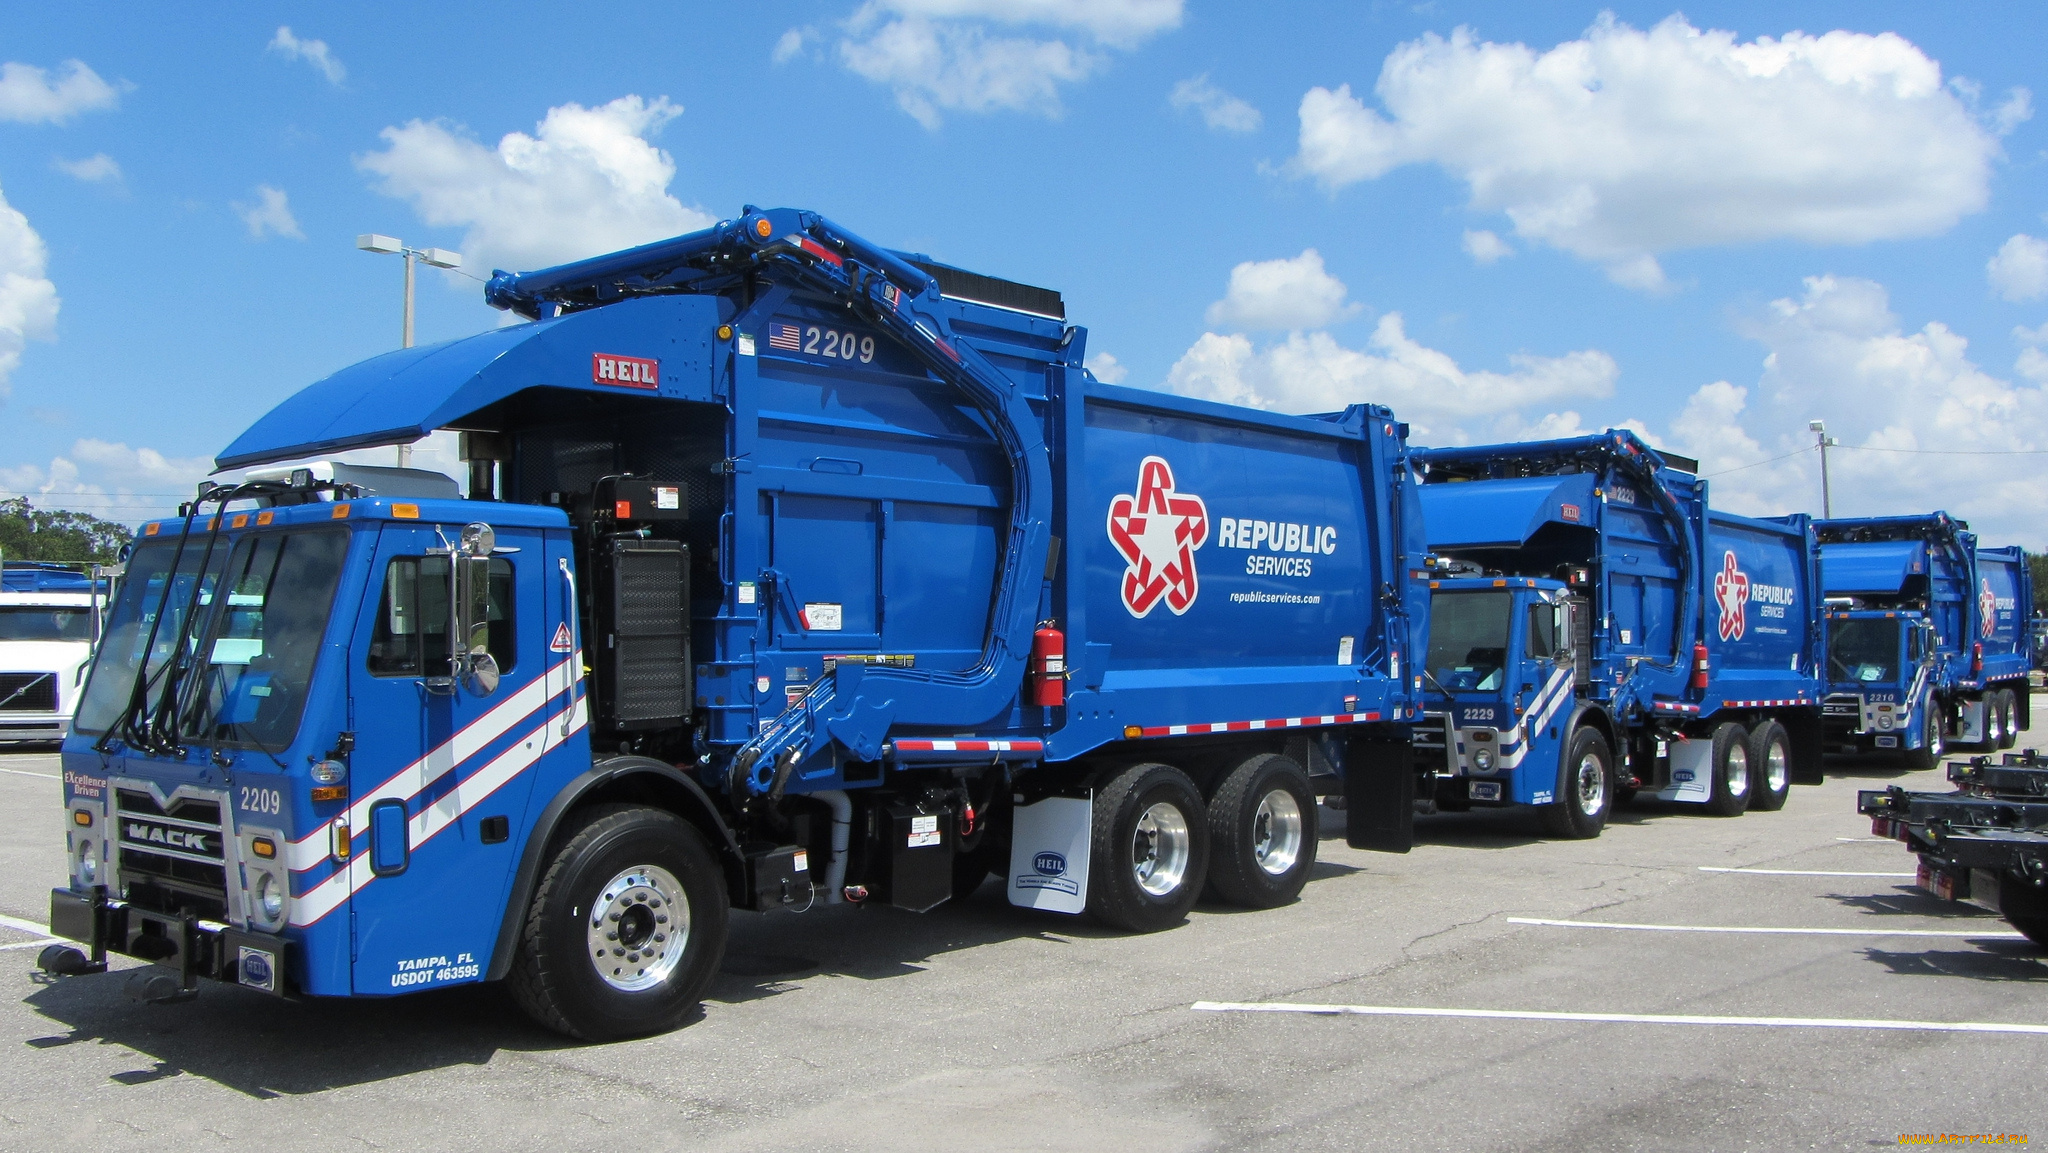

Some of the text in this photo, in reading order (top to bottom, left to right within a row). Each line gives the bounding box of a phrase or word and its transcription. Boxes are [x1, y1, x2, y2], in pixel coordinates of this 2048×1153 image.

[804, 327, 875, 364] 2209
[598, 358, 654, 384] HEIL
[1219, 518, 1336, 555] REPUBLIC
[1245, 555, 1312, 578] SERVICES
[1229, 591, 1320, 605] republicservices.com
[1751, 583, 1793, 606] REPUBLIC
[1869, 693, 1894, 702] 2210
[1463, 708, 1494, 720] 2229
[74, 785, 99, 796] Driven
[240, 786, 280, 815] 2209
[129, 824, 208, 850] MACK
[1037, 858, 1064, 871] HEIL
[245, 959, 268, 977] HEIL
[397, 952, 474, 971] TAMPA, FL
[391, 964, 479, 987] USDOT 463595
